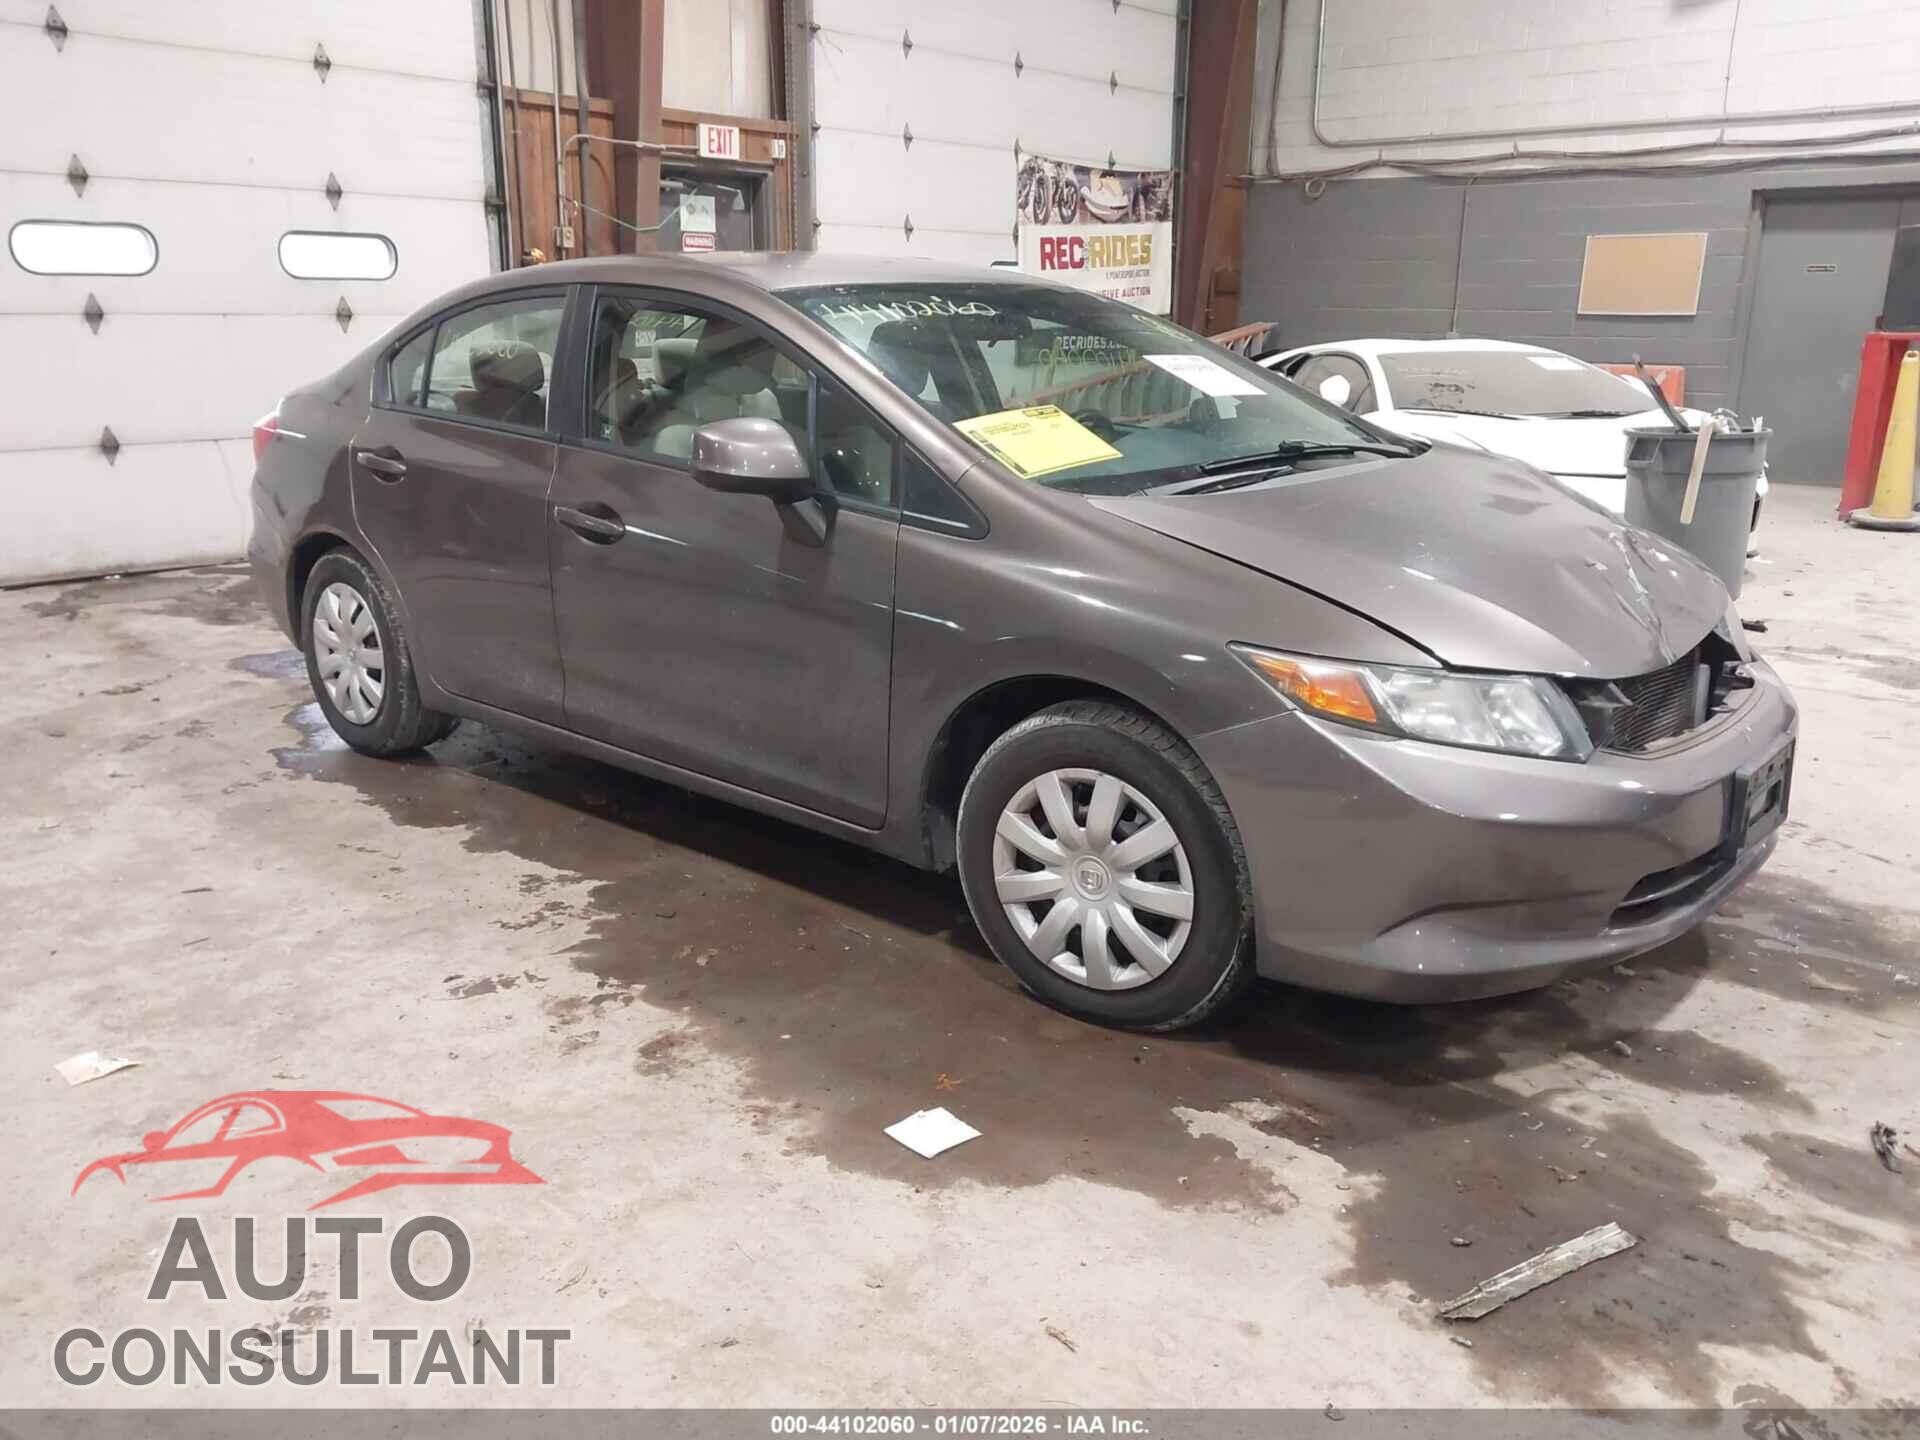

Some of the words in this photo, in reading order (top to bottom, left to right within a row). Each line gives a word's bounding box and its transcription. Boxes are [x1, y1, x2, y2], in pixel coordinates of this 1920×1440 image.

[707, 126, 735, 156] EXIT
[1040, 236, 1085, 271] REC
[1088, 234, 1153, 268] RIDES
[1121, 286, 1151, 298] AUCTION
